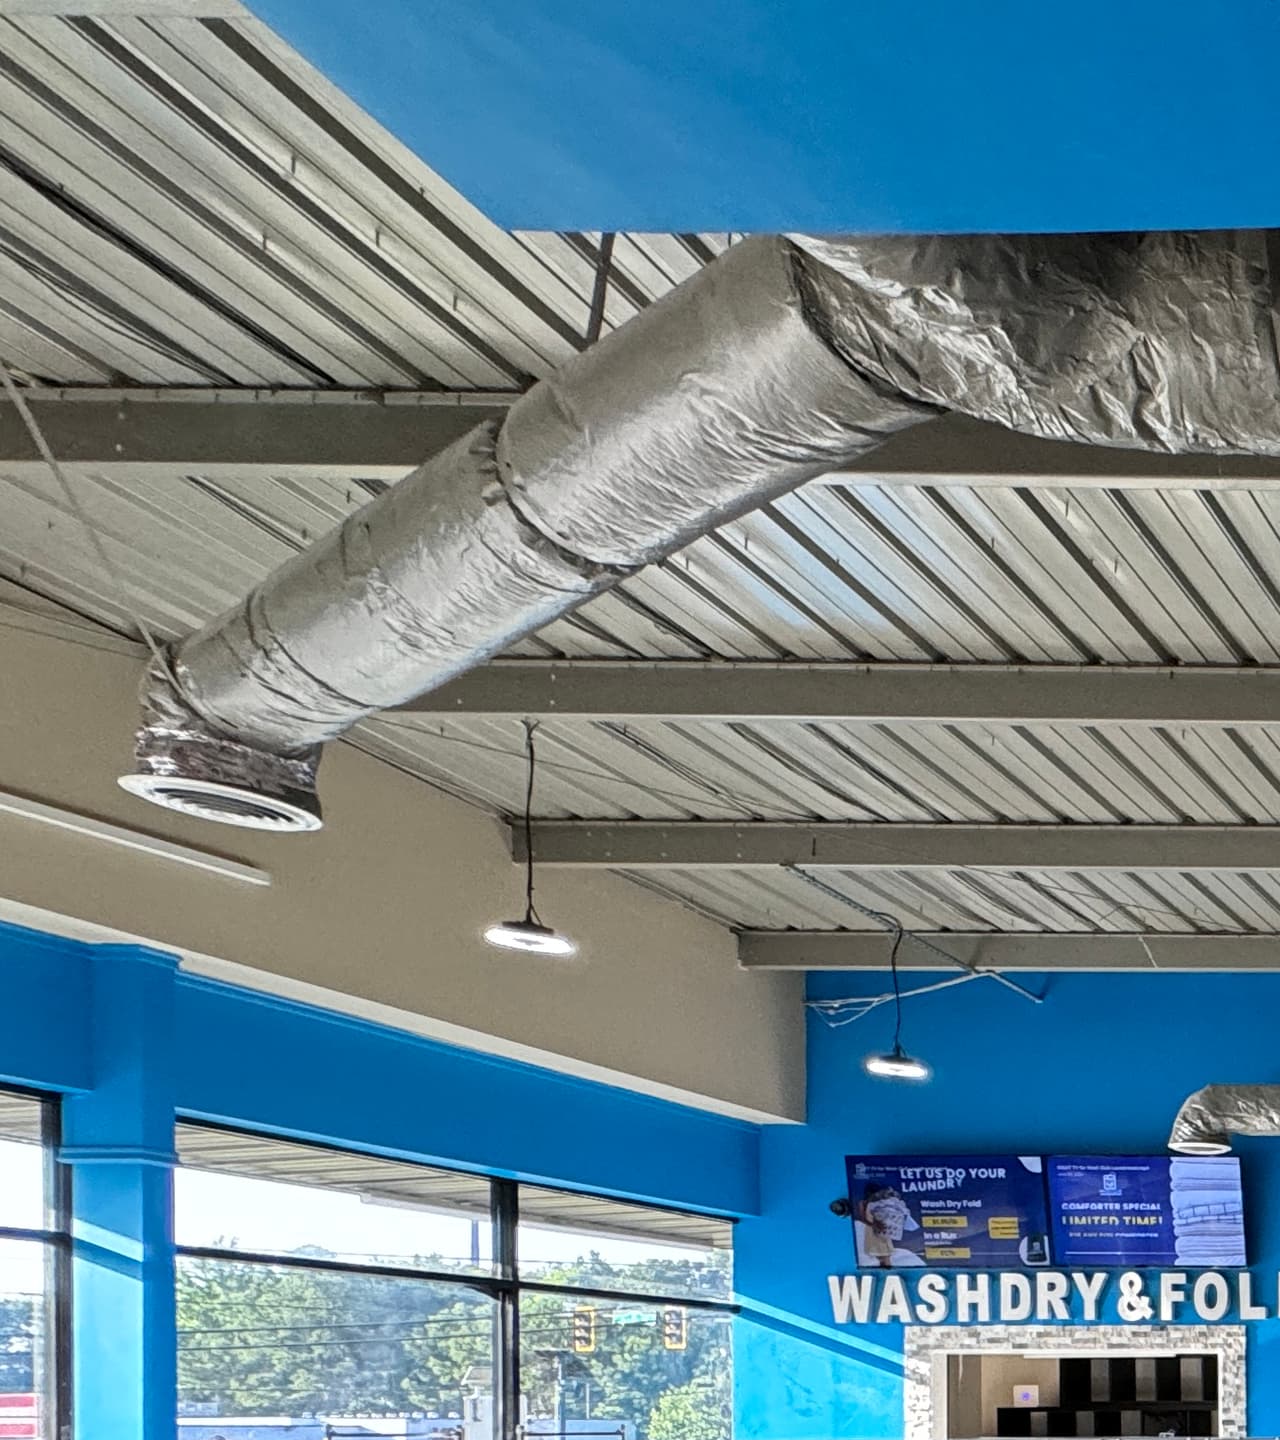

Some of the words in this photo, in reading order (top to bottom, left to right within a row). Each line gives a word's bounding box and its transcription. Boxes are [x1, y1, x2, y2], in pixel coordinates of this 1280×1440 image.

[901, 1168, 921, 1180] LET
[925, 1168, 942, 1180] US
[949, 1167, 966, 1180] DO
[969, 1167, 1006, 1179] YOUR
[902, 1177, 963, 1193] LAUNDRY
